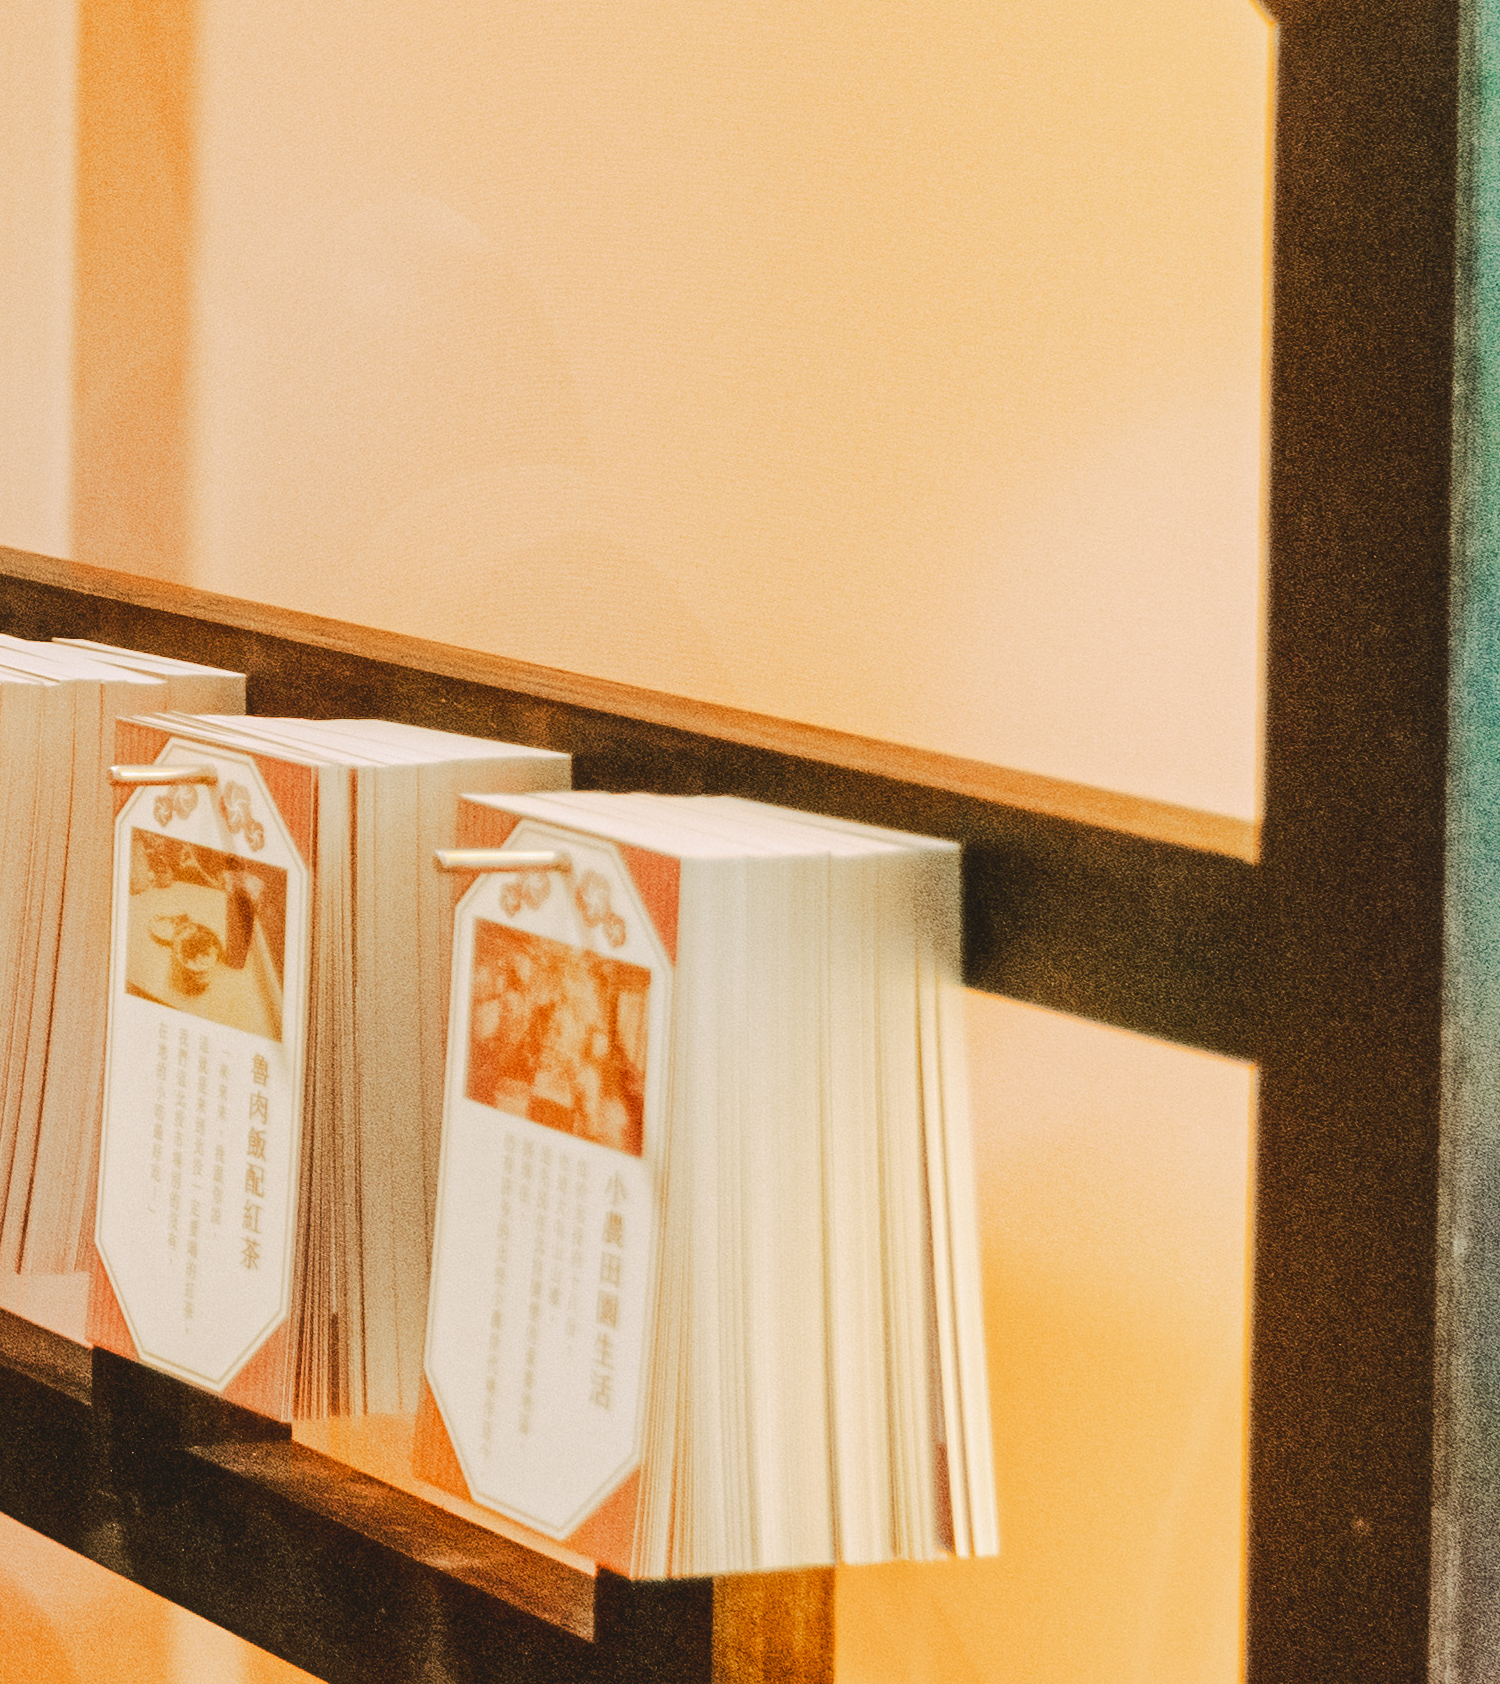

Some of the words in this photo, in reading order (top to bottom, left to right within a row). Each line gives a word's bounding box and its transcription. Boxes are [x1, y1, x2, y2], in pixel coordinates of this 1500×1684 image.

[239, 1052, 269, 1271] 魯肉飯配紅茶
